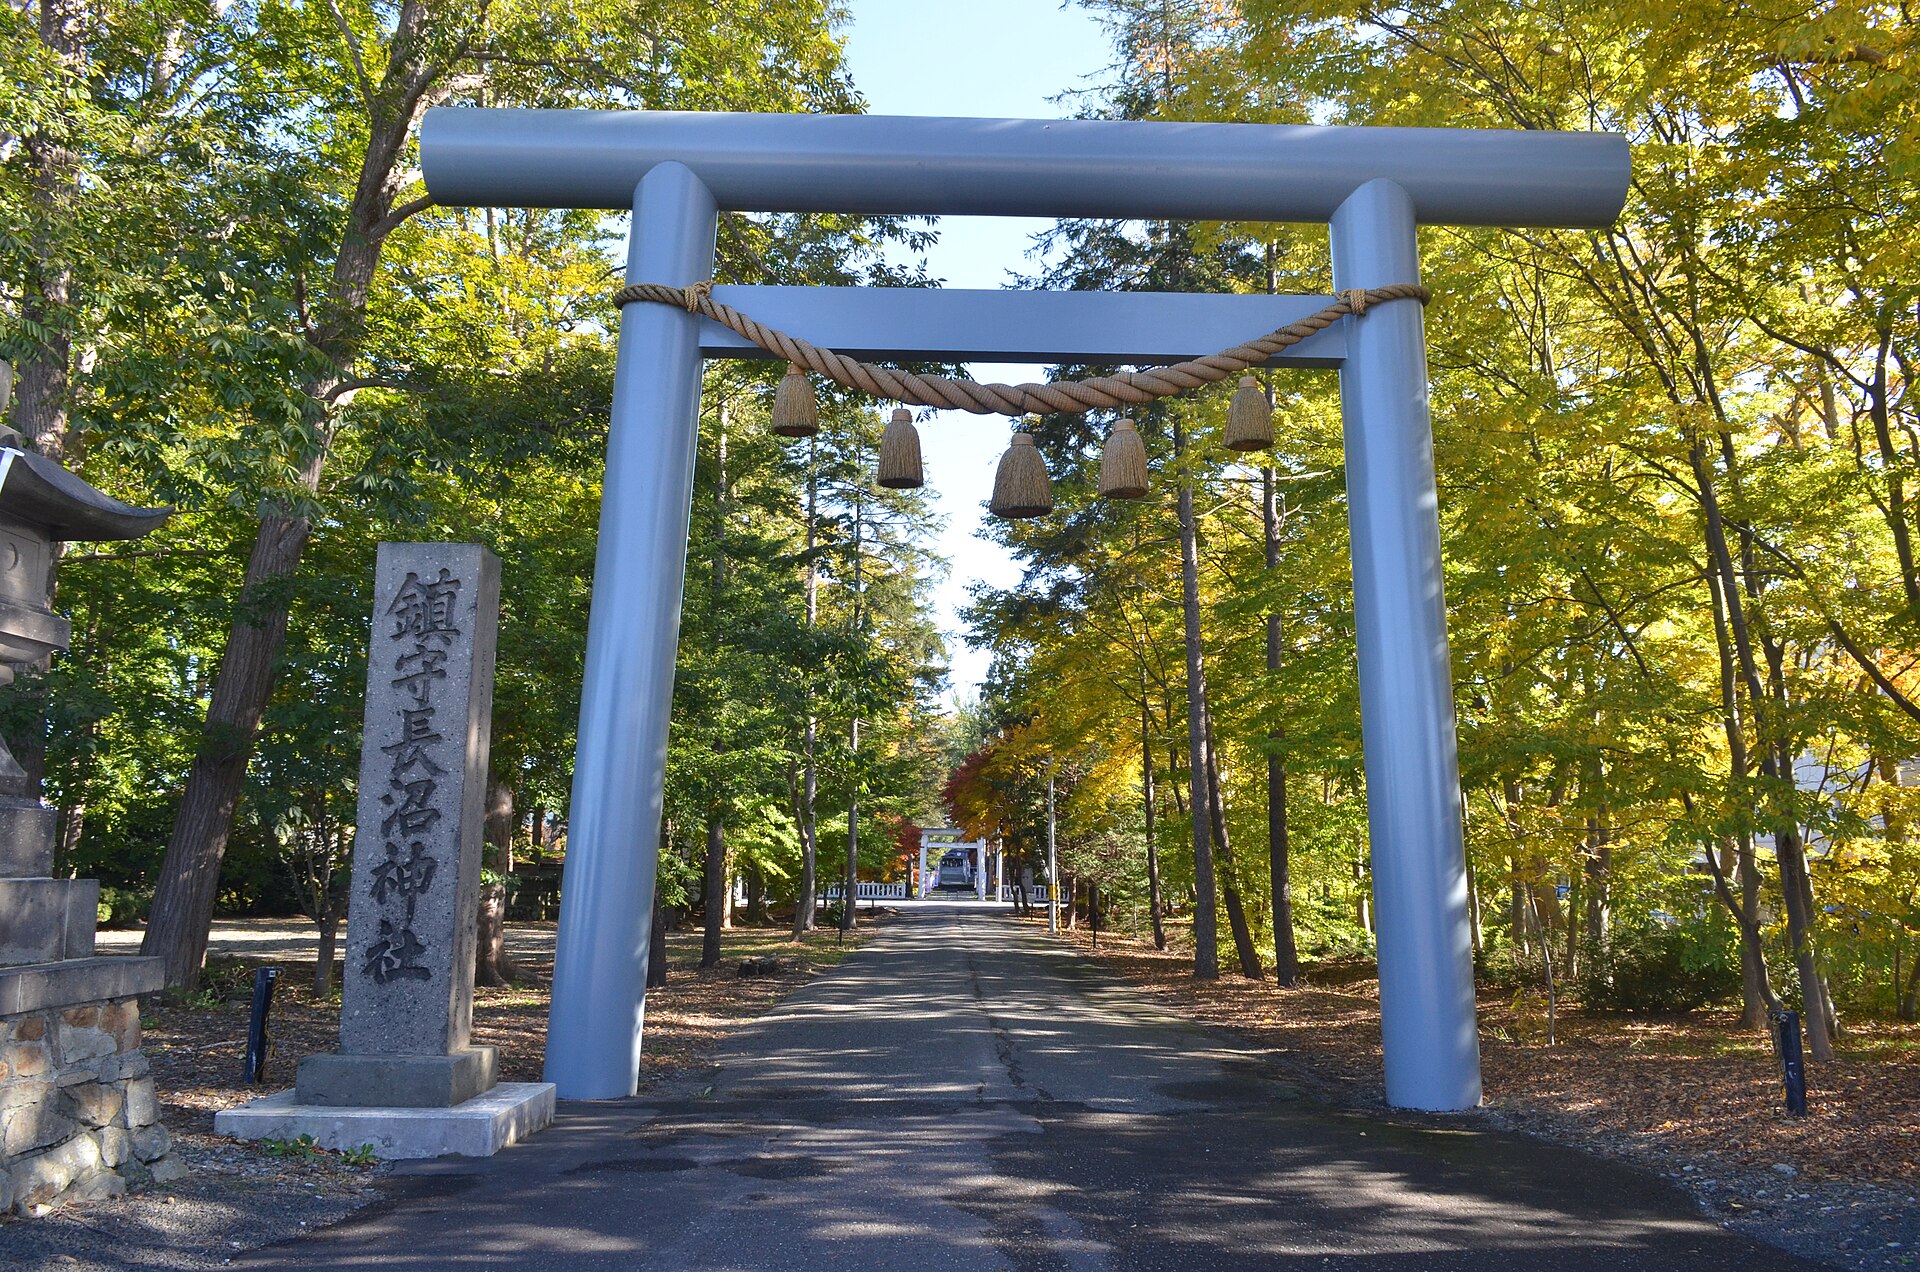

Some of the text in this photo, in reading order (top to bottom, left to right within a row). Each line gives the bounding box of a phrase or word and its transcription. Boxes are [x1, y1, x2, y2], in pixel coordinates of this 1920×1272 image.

[361, 568, 461, 984] 鎮守長沼神社
